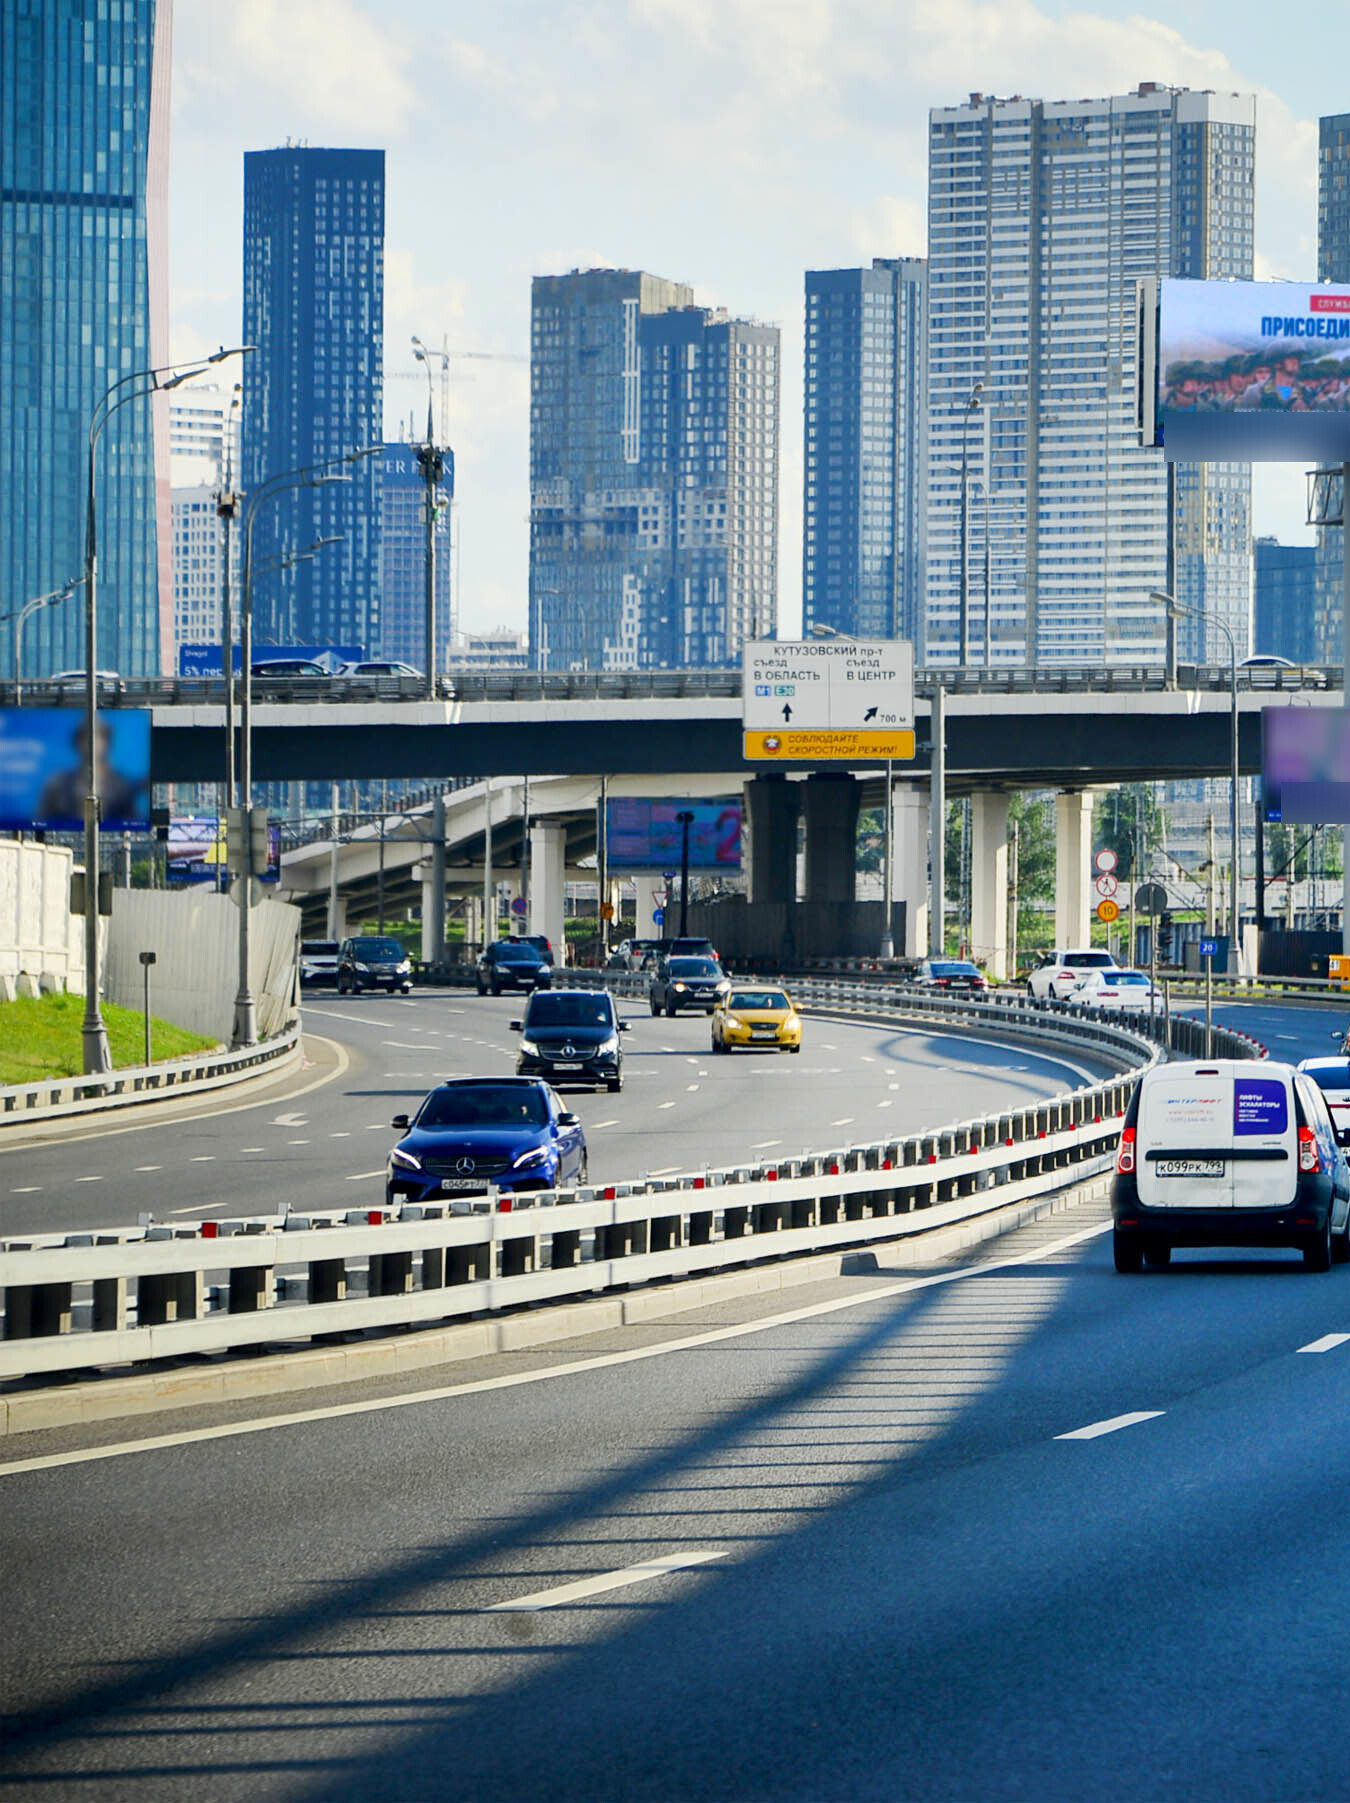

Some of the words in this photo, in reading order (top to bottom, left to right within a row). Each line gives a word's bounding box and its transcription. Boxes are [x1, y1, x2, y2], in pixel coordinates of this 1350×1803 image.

[774, 645, 857, 656] КУТУЗОВСКИЙ
[860, 648, 884, 658] пр-т
[753, 659, 788, 668] съезд
[846, 659, 880, 668] съезд
[754, 671, 762, 681] В
[765, 671, 821, 681] ОБЛАСТЬ
[847, 671, 854, 681] В
[858, 671, 896, 682] ЦЕНТР
[788, 734, 859, 744] СОБЛЮДАЙТЕ
[788, 744, 856, 754] СКОРОСТНОЙ
